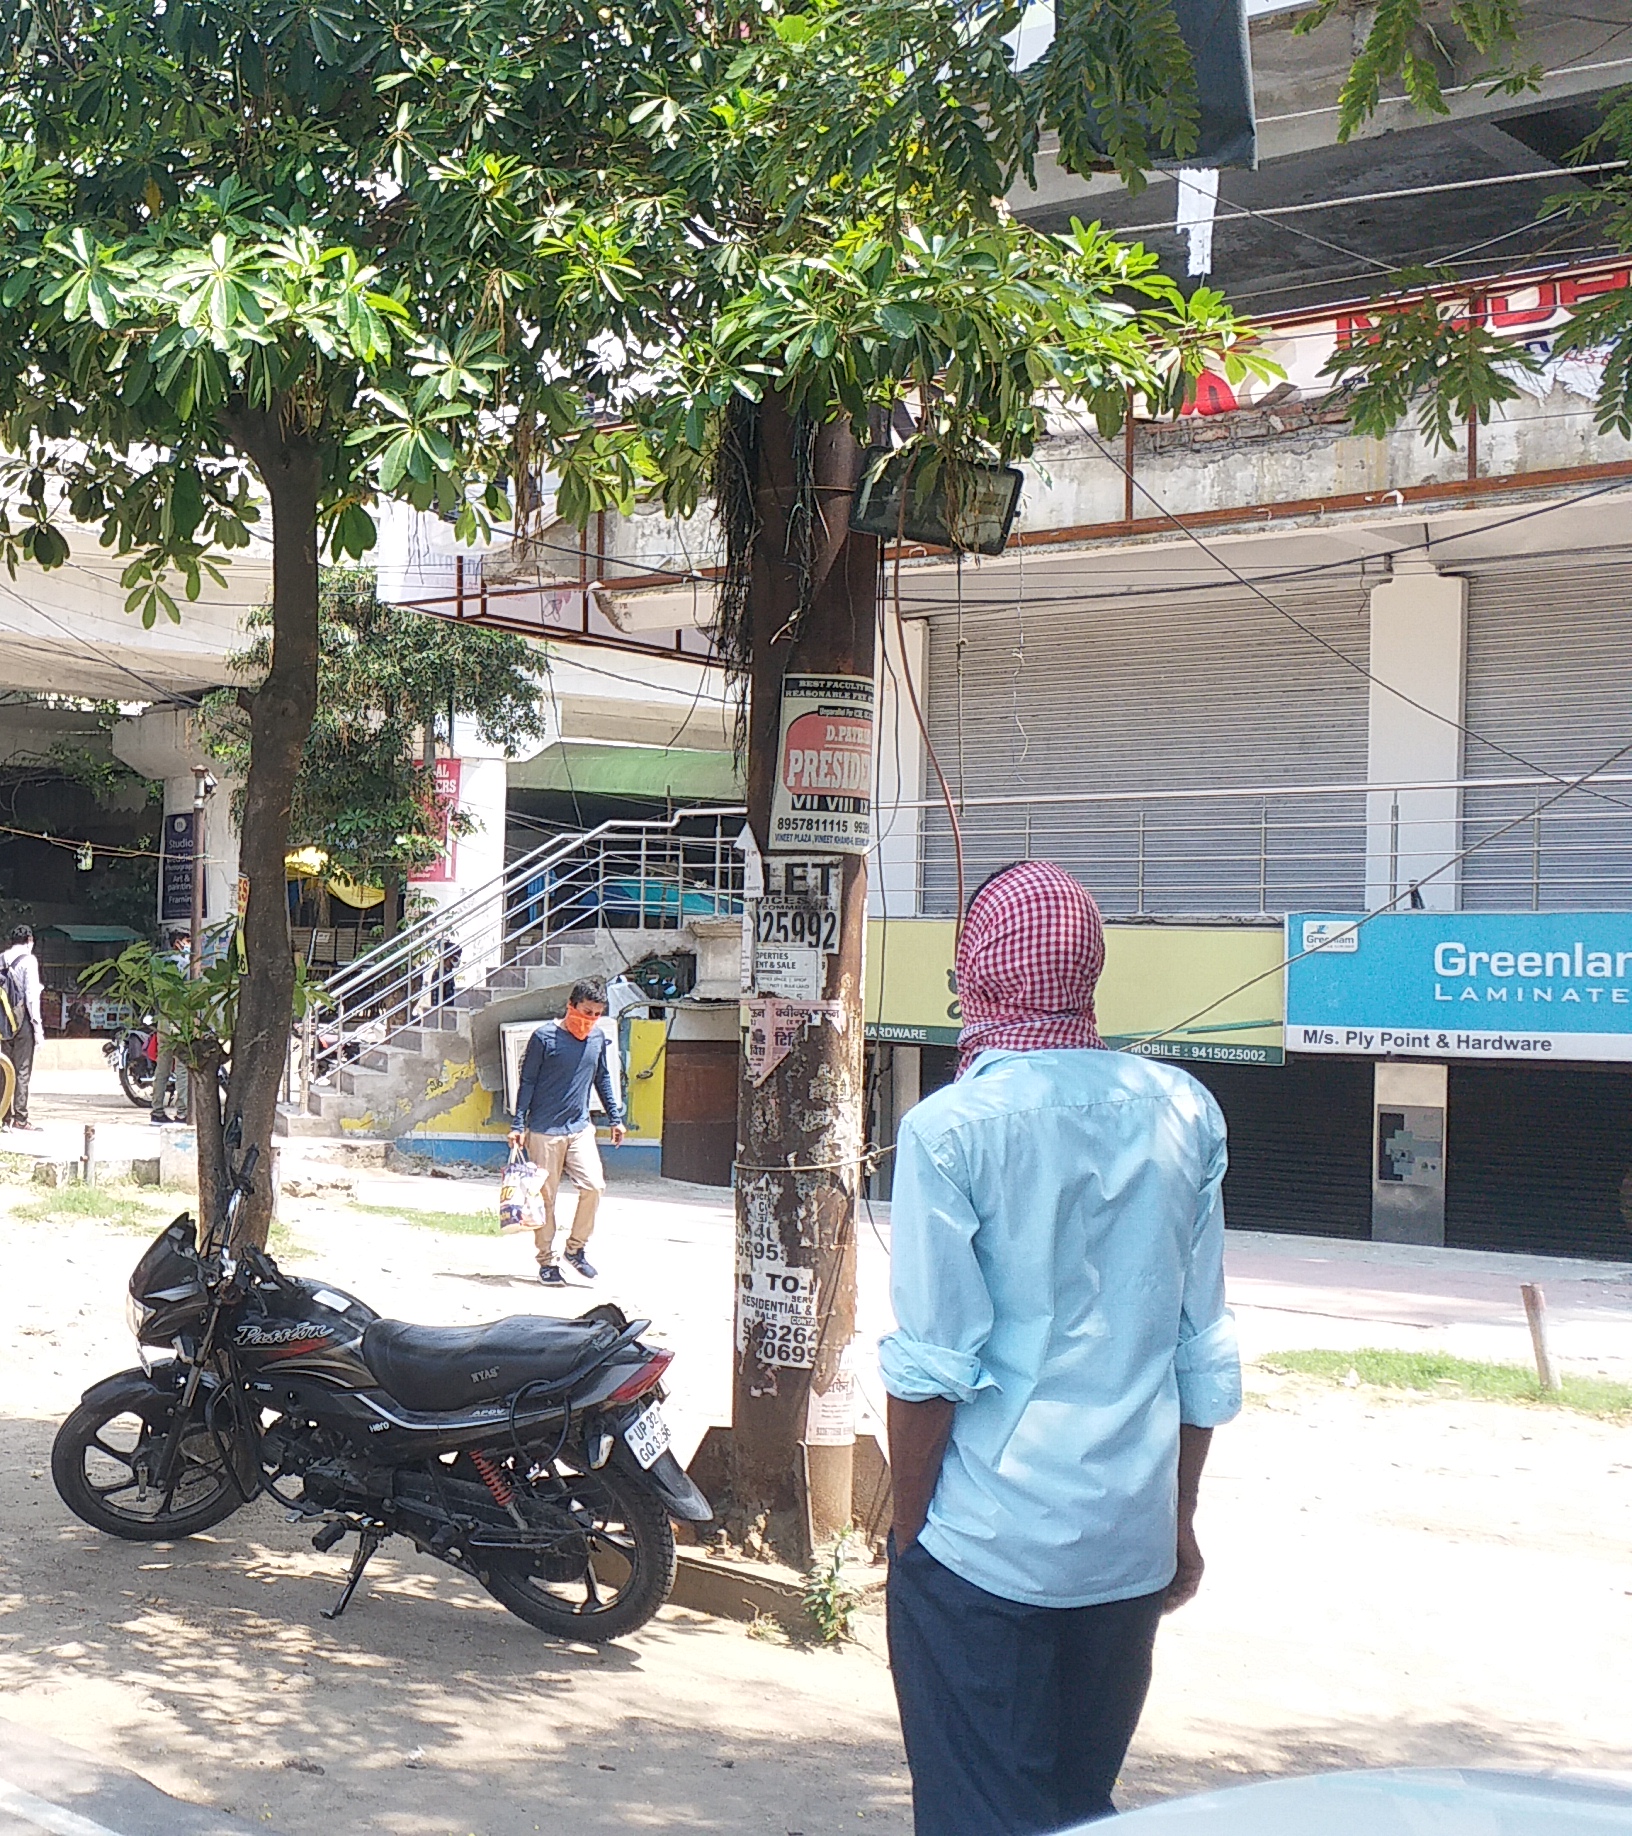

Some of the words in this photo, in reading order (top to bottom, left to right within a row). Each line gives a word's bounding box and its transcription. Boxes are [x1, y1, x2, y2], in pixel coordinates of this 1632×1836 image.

[798, 680, 825, 688] BEST
[785, 690, 851, 700] REASONABLE
[792, 794, 819, 809] VII
[826, 797, 854, 812] VIII
[777, 817, 849, 833] 8957811115
[168, 838, 194, 849] Studio
[774, 833, 794, 842] VINEET
[172, 874, 183, 883] Art
[776, 961, 796, 969] SALE
[1434, 983, 1630, 1004] LAMINATE
[1303, 1029, 1339, 1046] M/s.
[1345, 1031, 1375, 1049] Ply
[1380, 1032, 1429, 1049] Point
[1436, 1035, 1450, 1049] &
[1457, 1034, 1552, 1052] Hardware
[1130, 1044, 1181, 1057] MOBILE
[1191, 1046, 1267, 1061] 9415025002
[742, 1294, 802, 1315] RESIDENTIAL
[804, 1305, 813, 1316] &
[754, 1309, 778, 1322] SALE
[234, 1322, 335, 1346] Passion
[470, 1367, 500, 1383] NYAS
[368, 1421, 390, 1434] Hero
[633, 1421, 647, 1441] UP
[646, 1411, 659, 1429] 32
[639, 1441, 657, 1463] GQ
